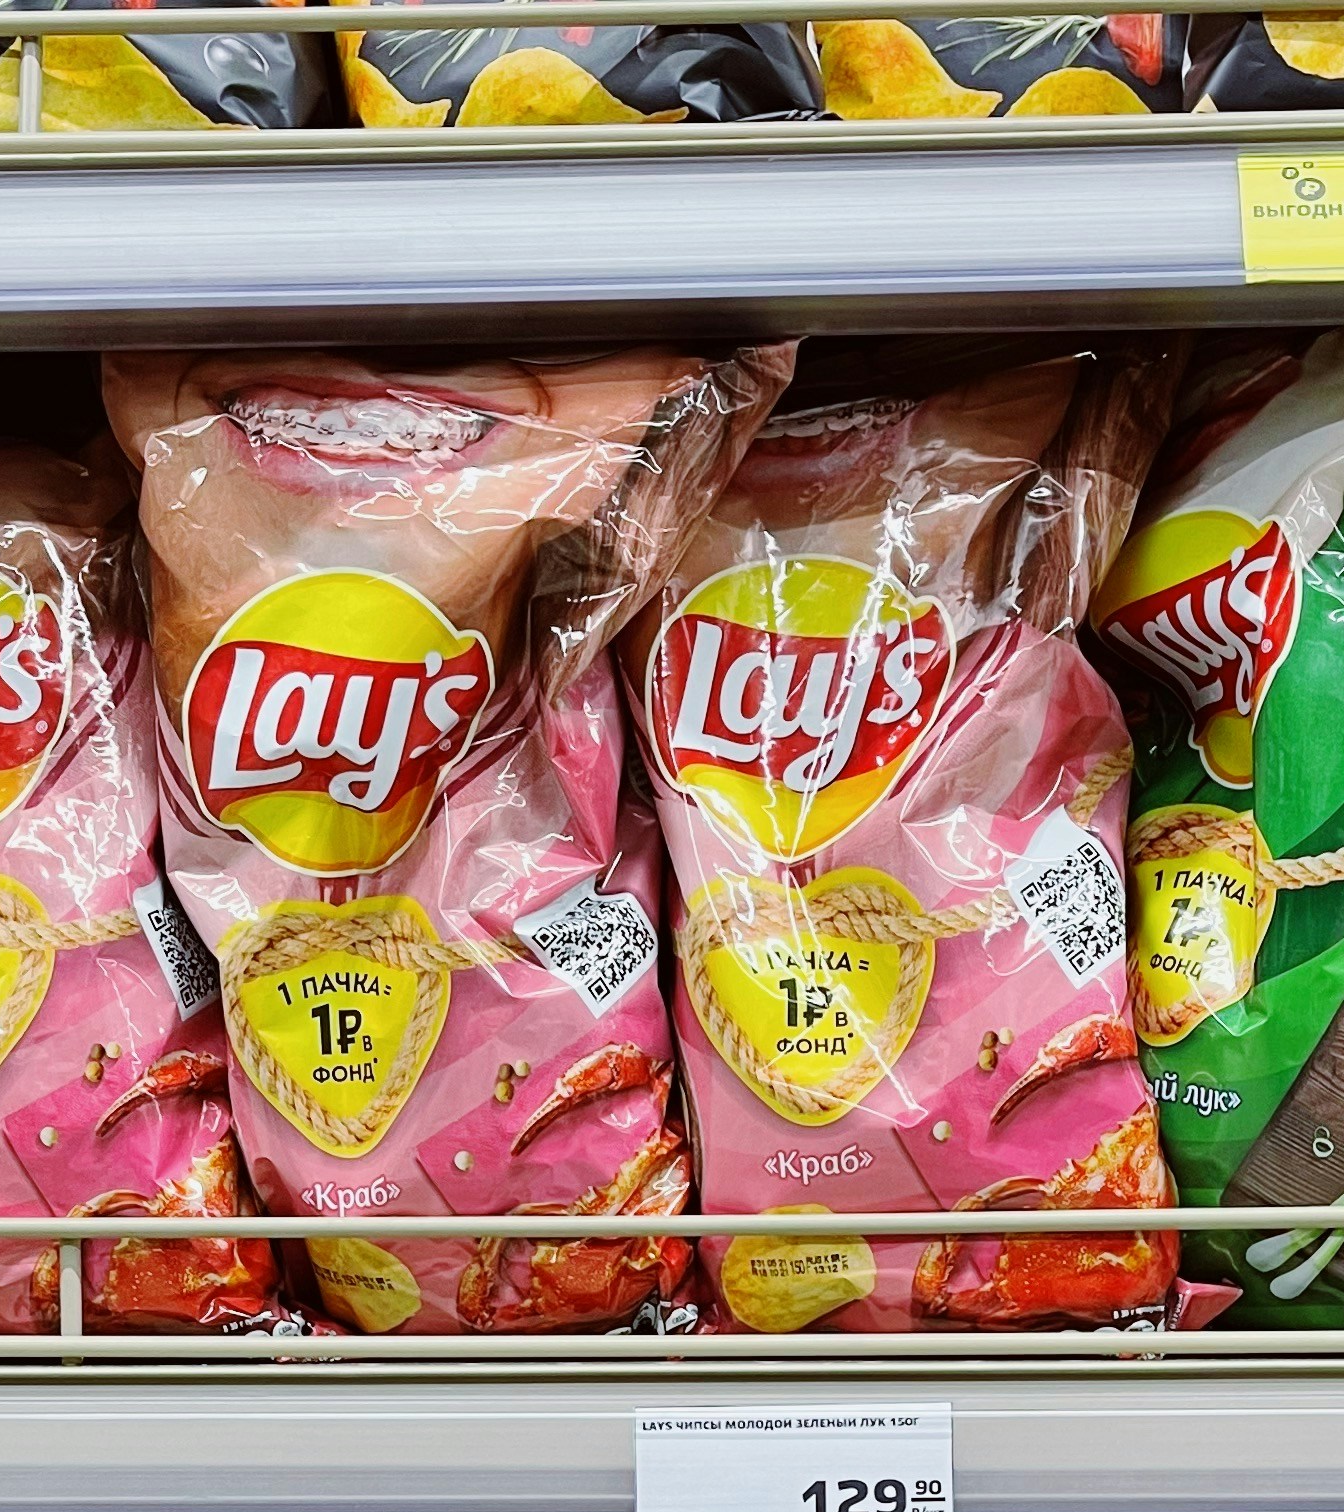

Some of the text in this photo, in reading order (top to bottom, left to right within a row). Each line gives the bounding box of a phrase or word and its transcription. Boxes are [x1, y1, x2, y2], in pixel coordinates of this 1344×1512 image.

[1108, 545, 1280, 716] Lay's
[671, 619, 937, 793] Lay's
[208, 647, 479, 812] Lay's
[766, 950, 853, 974] ПАЧКА
[301, 972, 380, 999] ПАЧКА
[1182, 1082, 1241, 1116] лук»
[763, 1146, 873, 1186] «Краб»
[300, 1176, 401, 1216] «Краб»
[642, 1420, 673, 1431] LAYS
[676, 1420, 722, 1431] ЧИПСЫ
[859, 1417, 886, 1428] ЛУК
[890, 1417, 920, 1427] 150Г
[914, 1479, 943, 1495] 90
